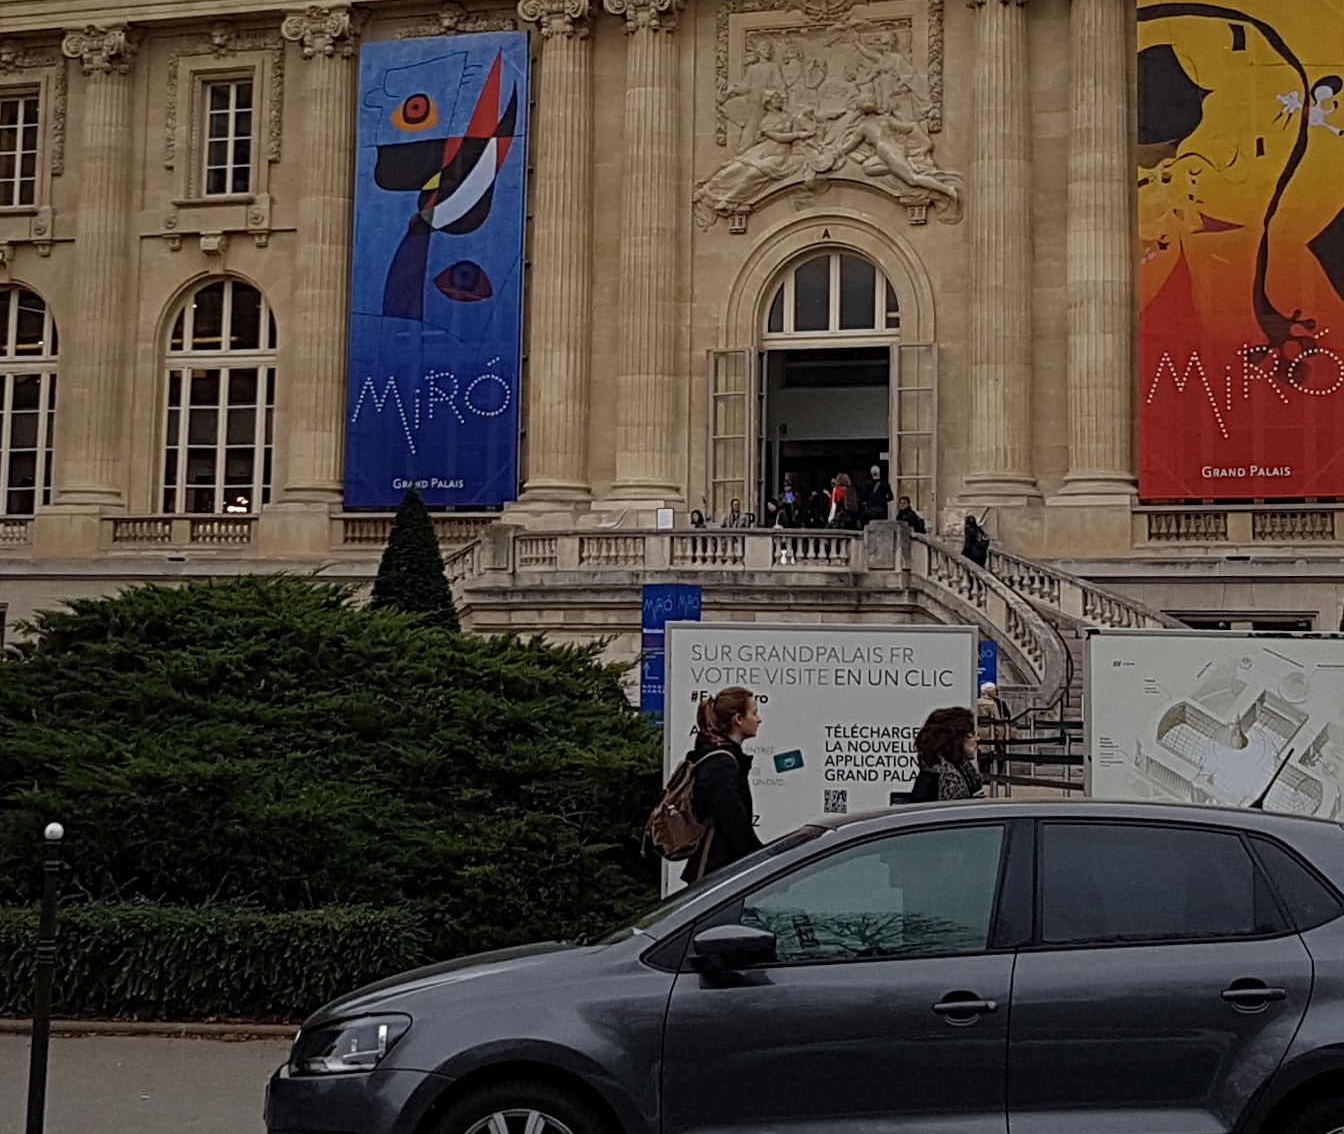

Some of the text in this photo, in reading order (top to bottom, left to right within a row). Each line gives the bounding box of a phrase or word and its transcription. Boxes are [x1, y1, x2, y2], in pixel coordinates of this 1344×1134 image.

[822, 228, 831, 240] A
[1201, 465, 1291, 478] GRAND PALAIS
[431, 478, 464, 489] PALAIS
[691, 644, 914, 664] SUR GRANDPALAIS.FR
[690, 666, 953, 687] VOTRE VISITE EN UN CLIC
[824, 723, 921, 739] TÉLÉCHARGE
[825, 740, 918, 754] LA NOUVELL
[824, 754, 919, 768] APPLICATION
[824, 768, 917, 782] GRAND PALA
